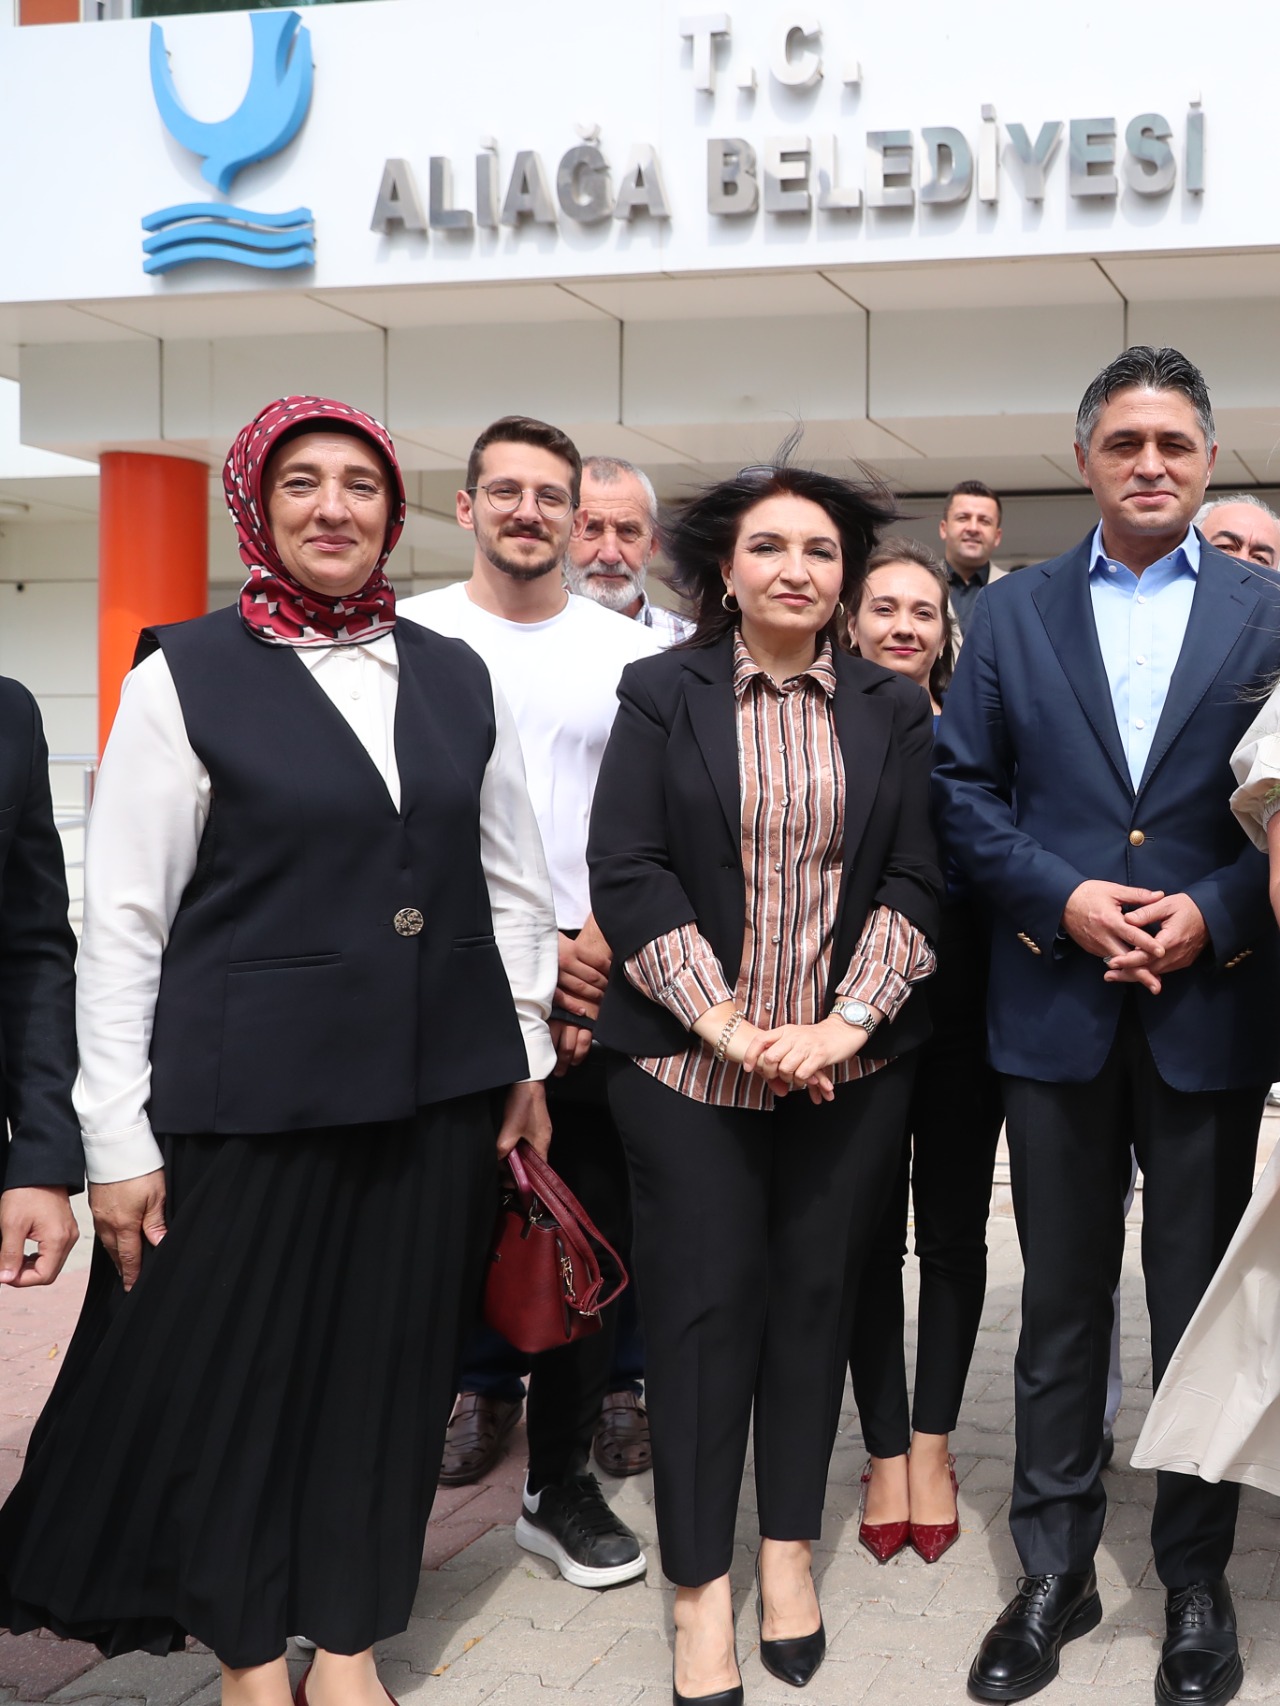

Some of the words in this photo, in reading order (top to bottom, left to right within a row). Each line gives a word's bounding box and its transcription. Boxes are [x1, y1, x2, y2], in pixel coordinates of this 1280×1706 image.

[679, 11, 862, 94] T.C.
[370, 122, 672, 236] ALİAĞA
[707, 92, 1205, 215] BELEDİYESİ
